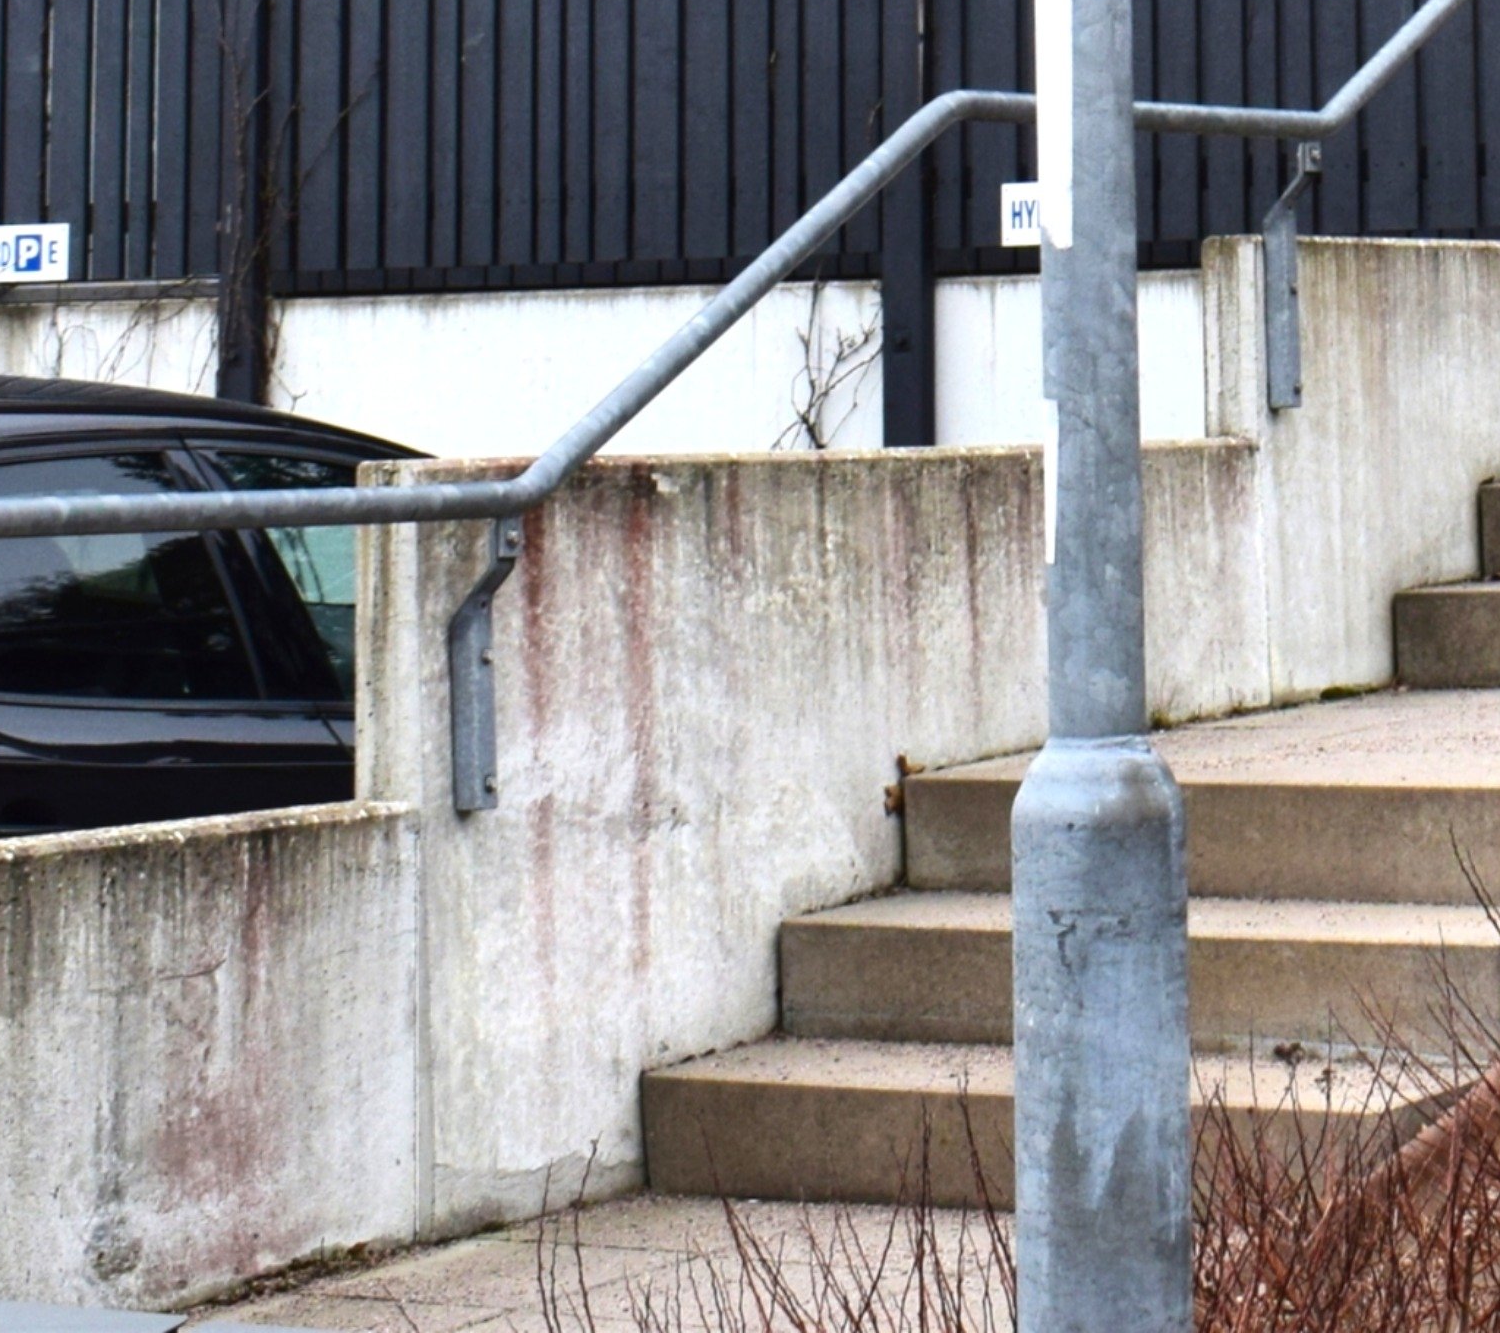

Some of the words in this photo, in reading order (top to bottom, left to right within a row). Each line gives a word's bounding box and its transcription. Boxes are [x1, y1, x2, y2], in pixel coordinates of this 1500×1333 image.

[1012, 200, 1041, 229] HY
[18, 238, 40, 269] P
[48, 240, 58, 264] E
